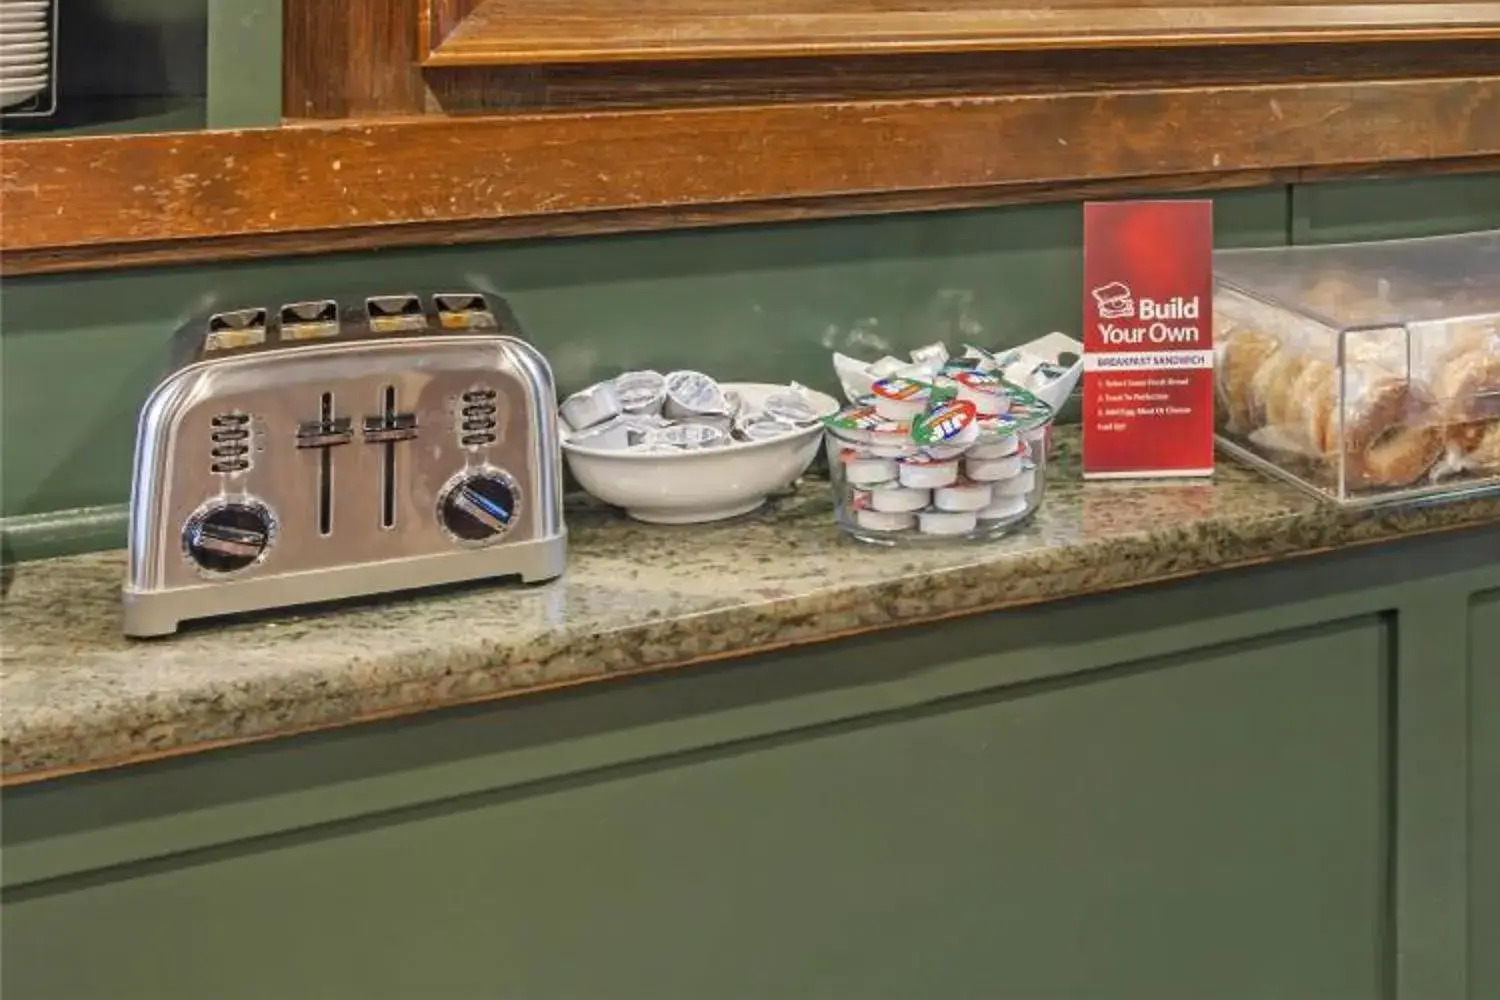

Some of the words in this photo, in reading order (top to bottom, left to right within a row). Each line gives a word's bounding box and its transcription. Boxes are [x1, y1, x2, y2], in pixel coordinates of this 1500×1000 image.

[1139, 296, 1199, 320] Build
[1098, 323, 1147, 344] Your
[1149, 322, 1199, 343] Own
[1097, 357, 1151, 367] BREAKFAST
[1153, 355, 1205, 365] SANDWICH
